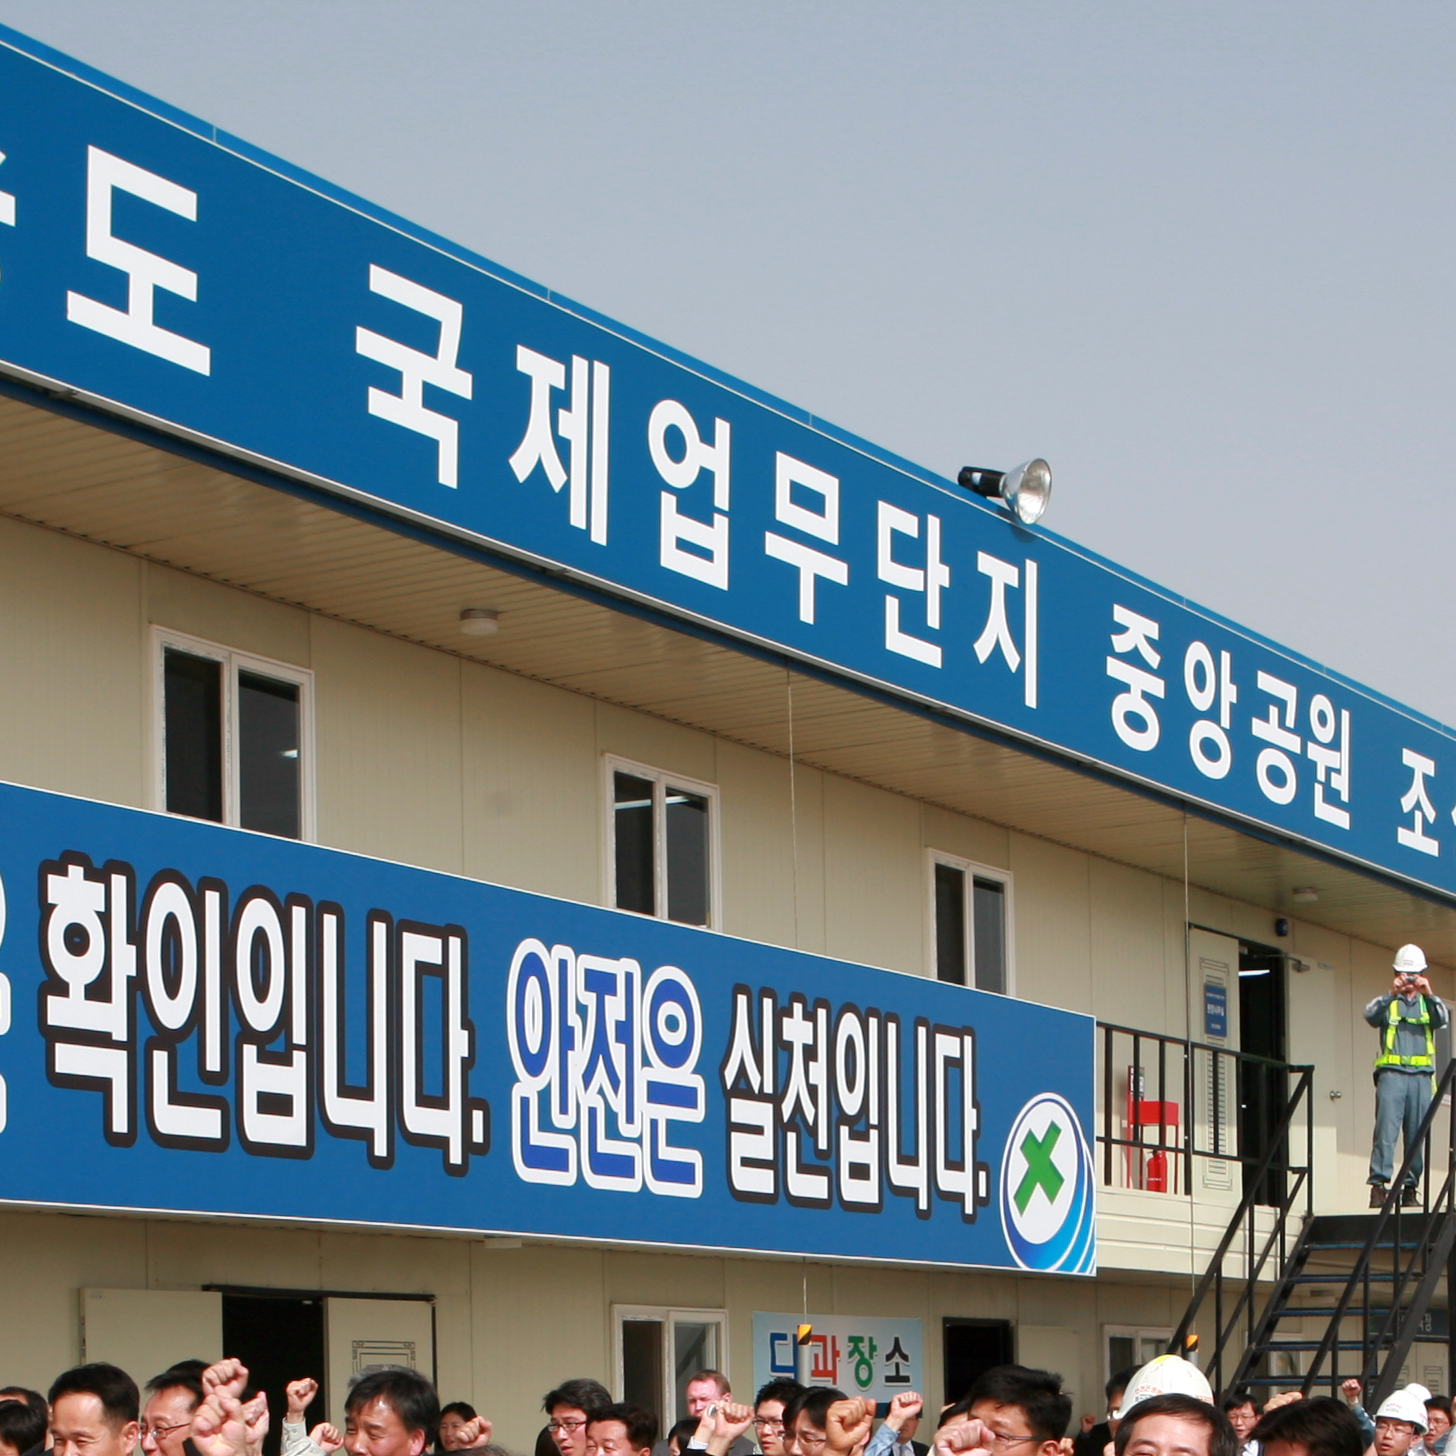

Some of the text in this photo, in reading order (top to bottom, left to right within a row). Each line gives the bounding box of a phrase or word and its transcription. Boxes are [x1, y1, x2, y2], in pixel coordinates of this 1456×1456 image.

[356, 263, 1038, 709] 국제업무단지
[1106, 604, 1350, 830] 중앙공원
[43, 858, 488, 1170] 확인입니다.
[507, 938, 705, 1199] 안전은
[721, 986, 989, 1218] 실천입니다.
